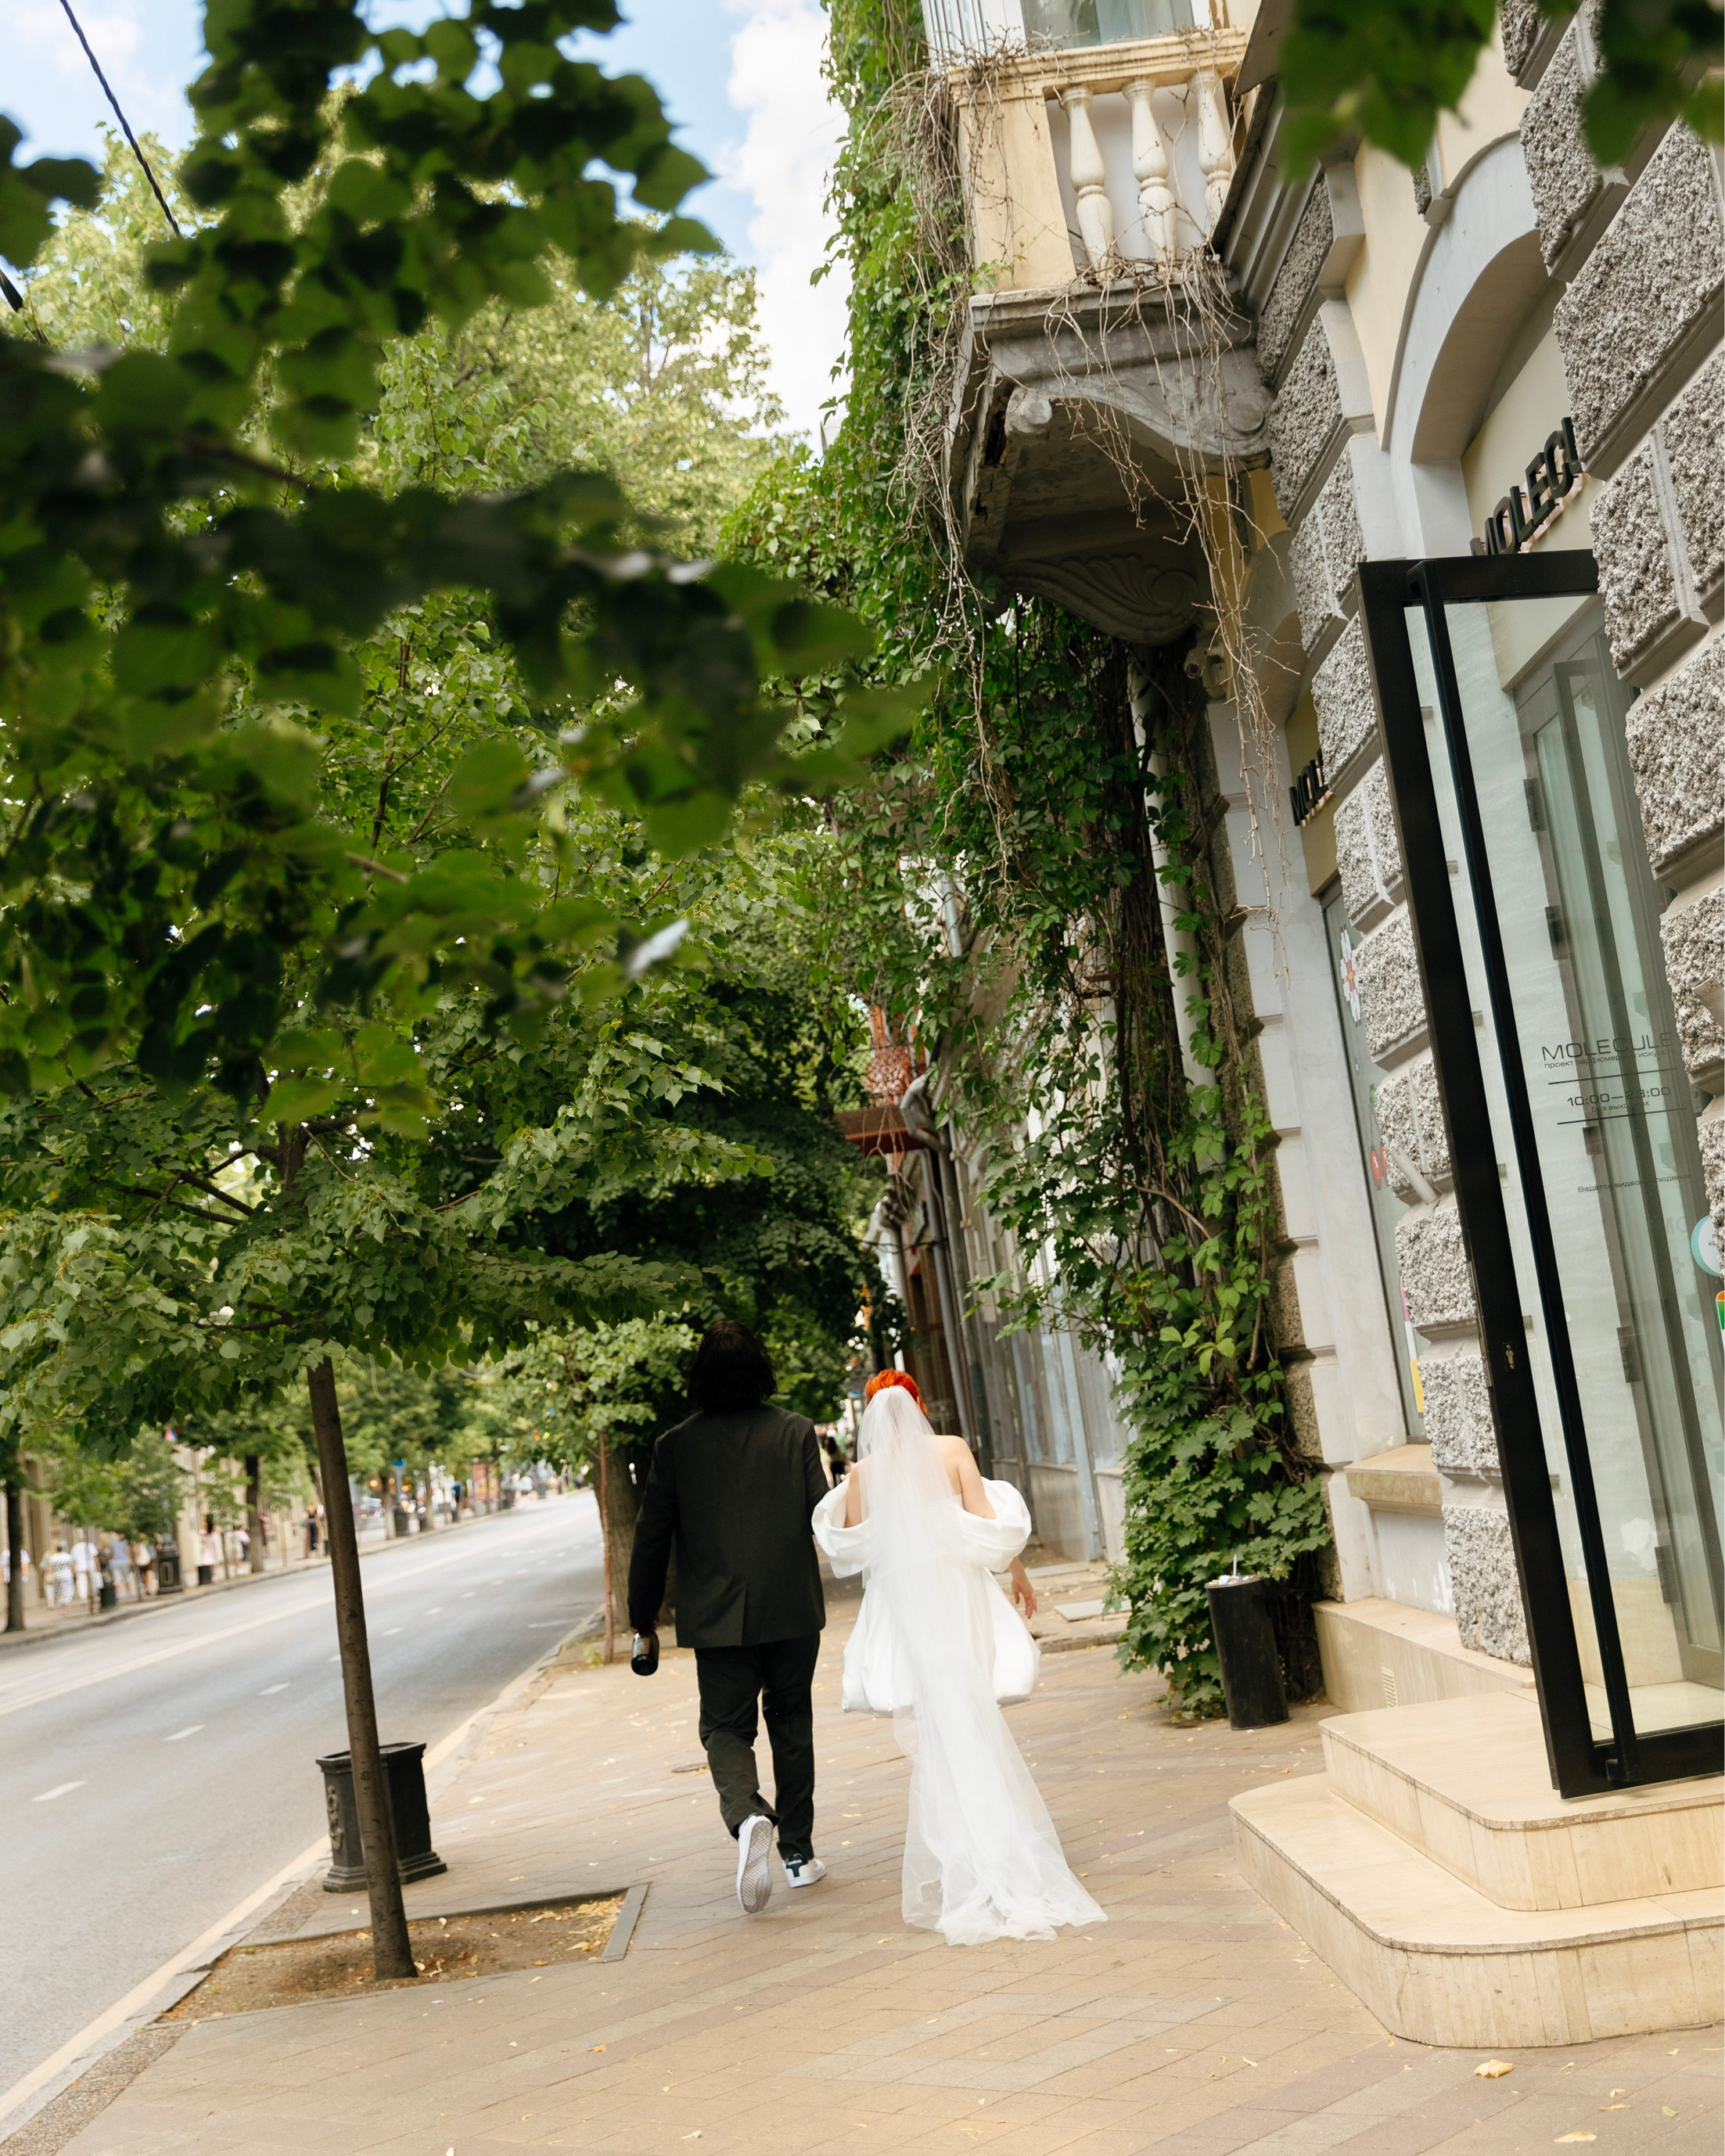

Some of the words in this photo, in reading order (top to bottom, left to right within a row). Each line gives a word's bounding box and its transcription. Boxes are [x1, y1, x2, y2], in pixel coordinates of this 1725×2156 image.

[1288, 751, 1328, 826] MOL
[1541, 1032, 1674, 1062] MOLECULE
[1544, 1060, 1574, 1069] проект
[1576, 1053, 1637, 1066] парфюмерх
[1608, 1101, 1650, 1110] выхох
